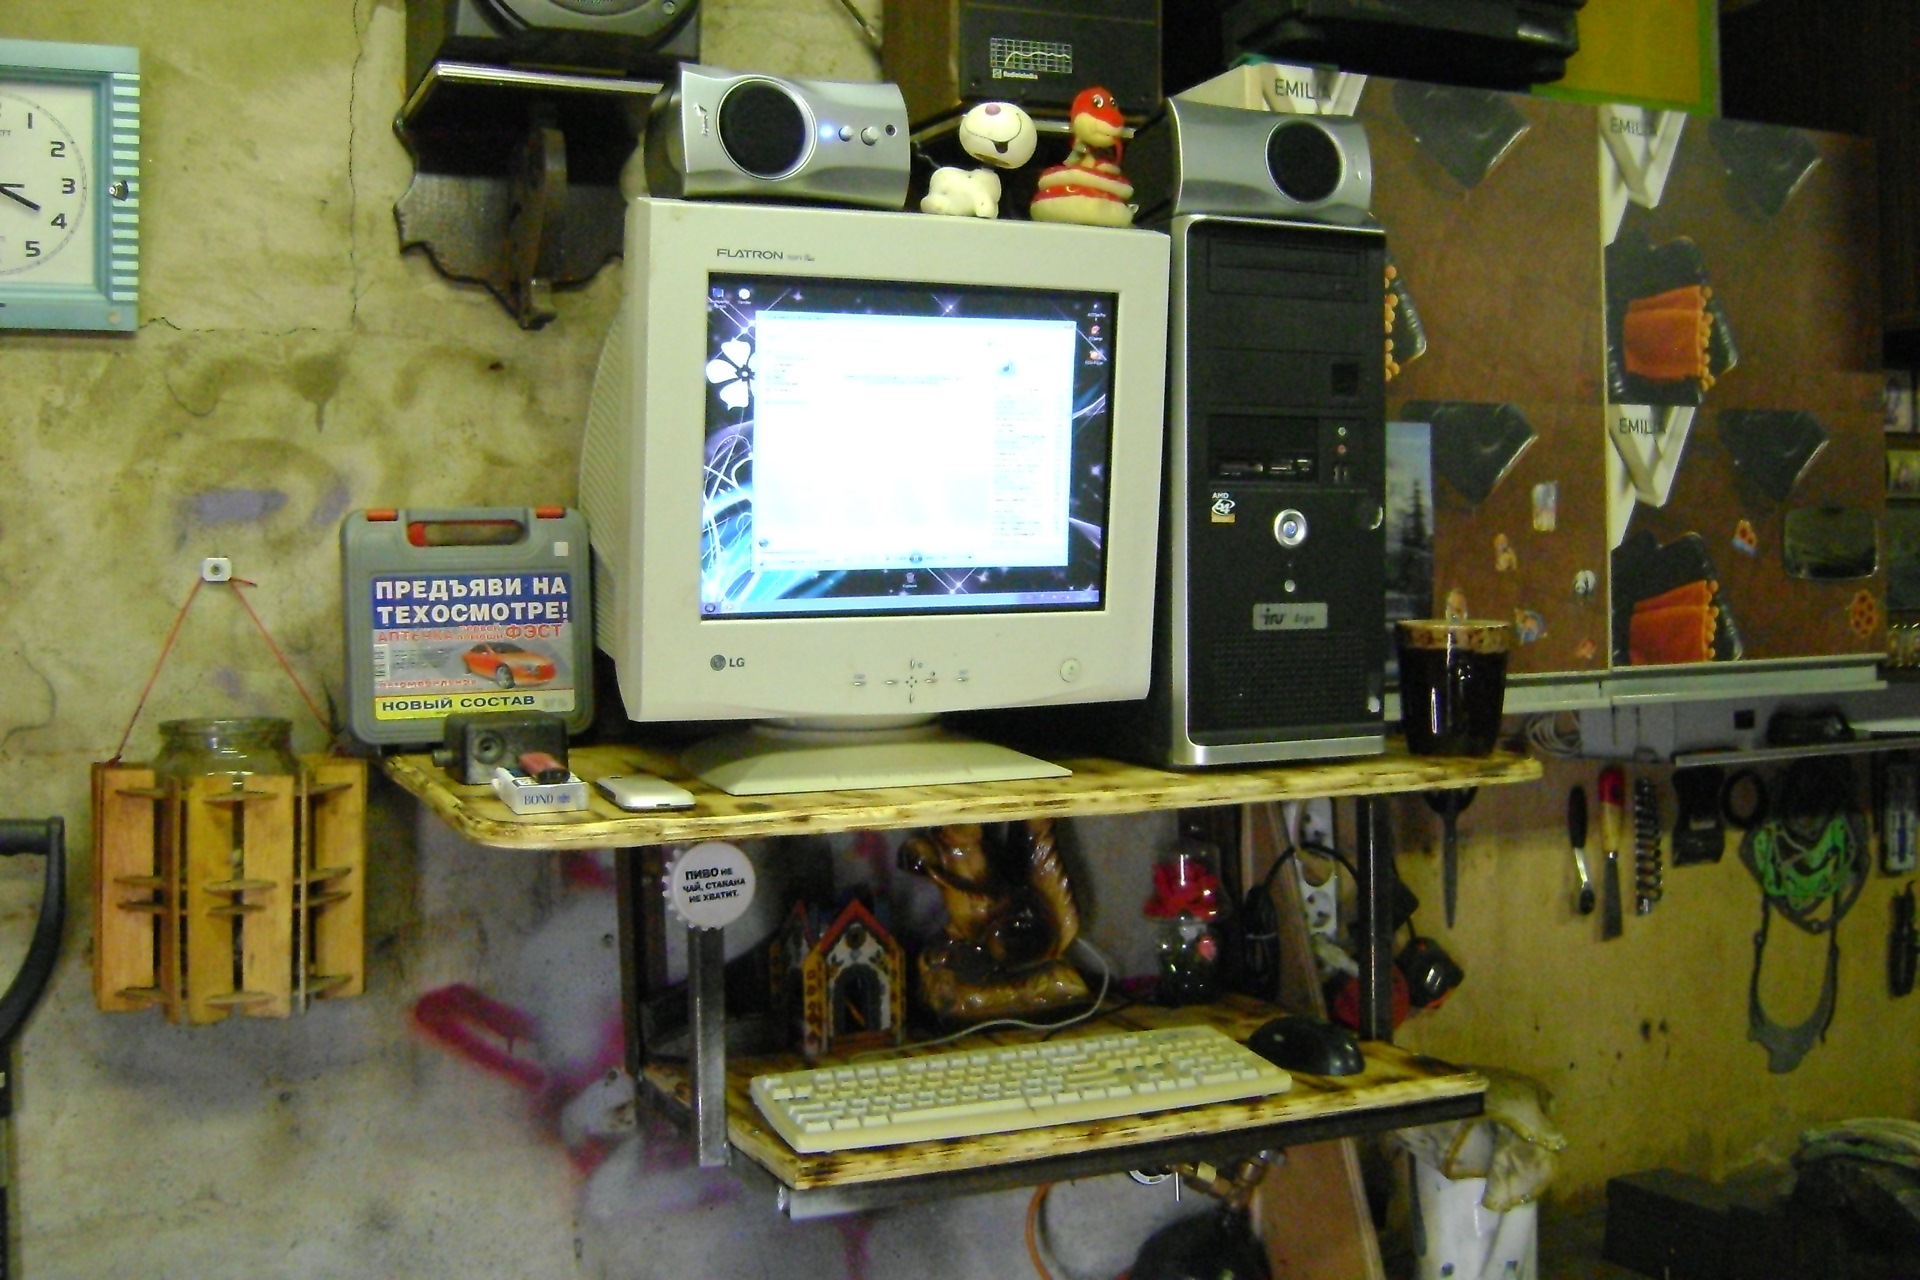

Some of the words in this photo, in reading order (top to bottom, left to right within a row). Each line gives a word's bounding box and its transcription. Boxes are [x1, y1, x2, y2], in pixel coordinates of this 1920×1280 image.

[28, 113, 33, 129] 1
[51, 141, 66, 158] 2
[62, 178, 76, 194] 3
[51, 213, 68, 230] 4
[26, 241, 41, 258] 5
[717, 248, 784, 260] FLATRON
[376, 578, 522, 601] ПРЕДЪЯВИ
[533, 576, 567, 595] НА
[377, 601, 569, 625] ТЕХОСМОТРЕ!
[504, 624, 563, 640] ФЭСТ
[729, 657, 745, 667] LG
[382, 697, 453, 711] НОВЫЙ
[460, 695, 536, 708] СОСТАВ
[524, 794, 554, 805] BOND
[685, 867, 719, 880] ПИВО
[720, 867, 733, 876] НЕ
[682, 881, 704, 893] ЧАЙ,
[705, 877, 746, 890] СТАКАНА
[688, 894, 702, 903] НЕ
